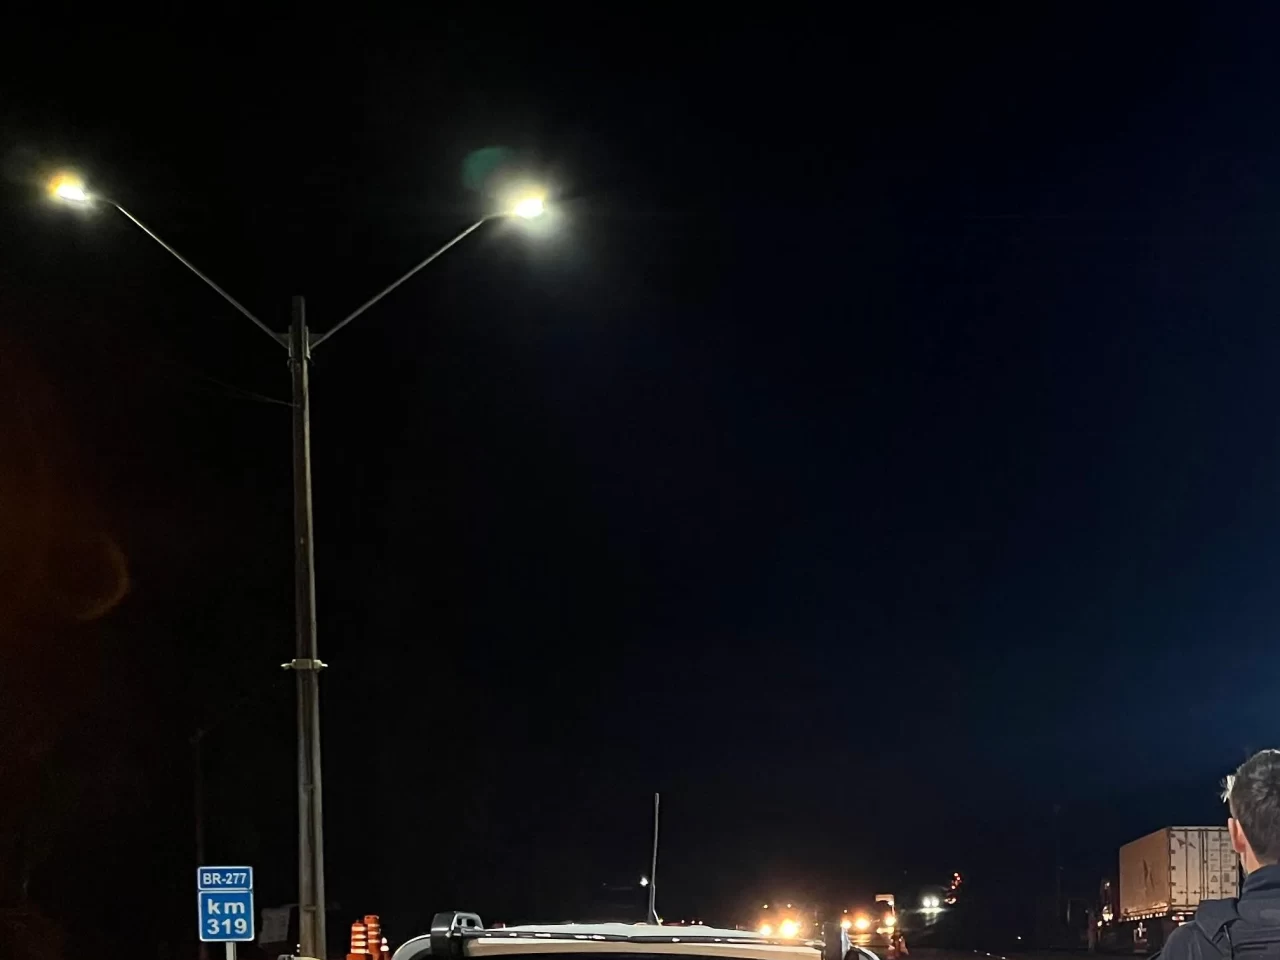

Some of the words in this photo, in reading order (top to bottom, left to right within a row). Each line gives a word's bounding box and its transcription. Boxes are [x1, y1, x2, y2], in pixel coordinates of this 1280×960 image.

[203, 873, 247, 885] BR-277
[207, 899, 245, 914] km
[207, 918, 247, 935] 319
